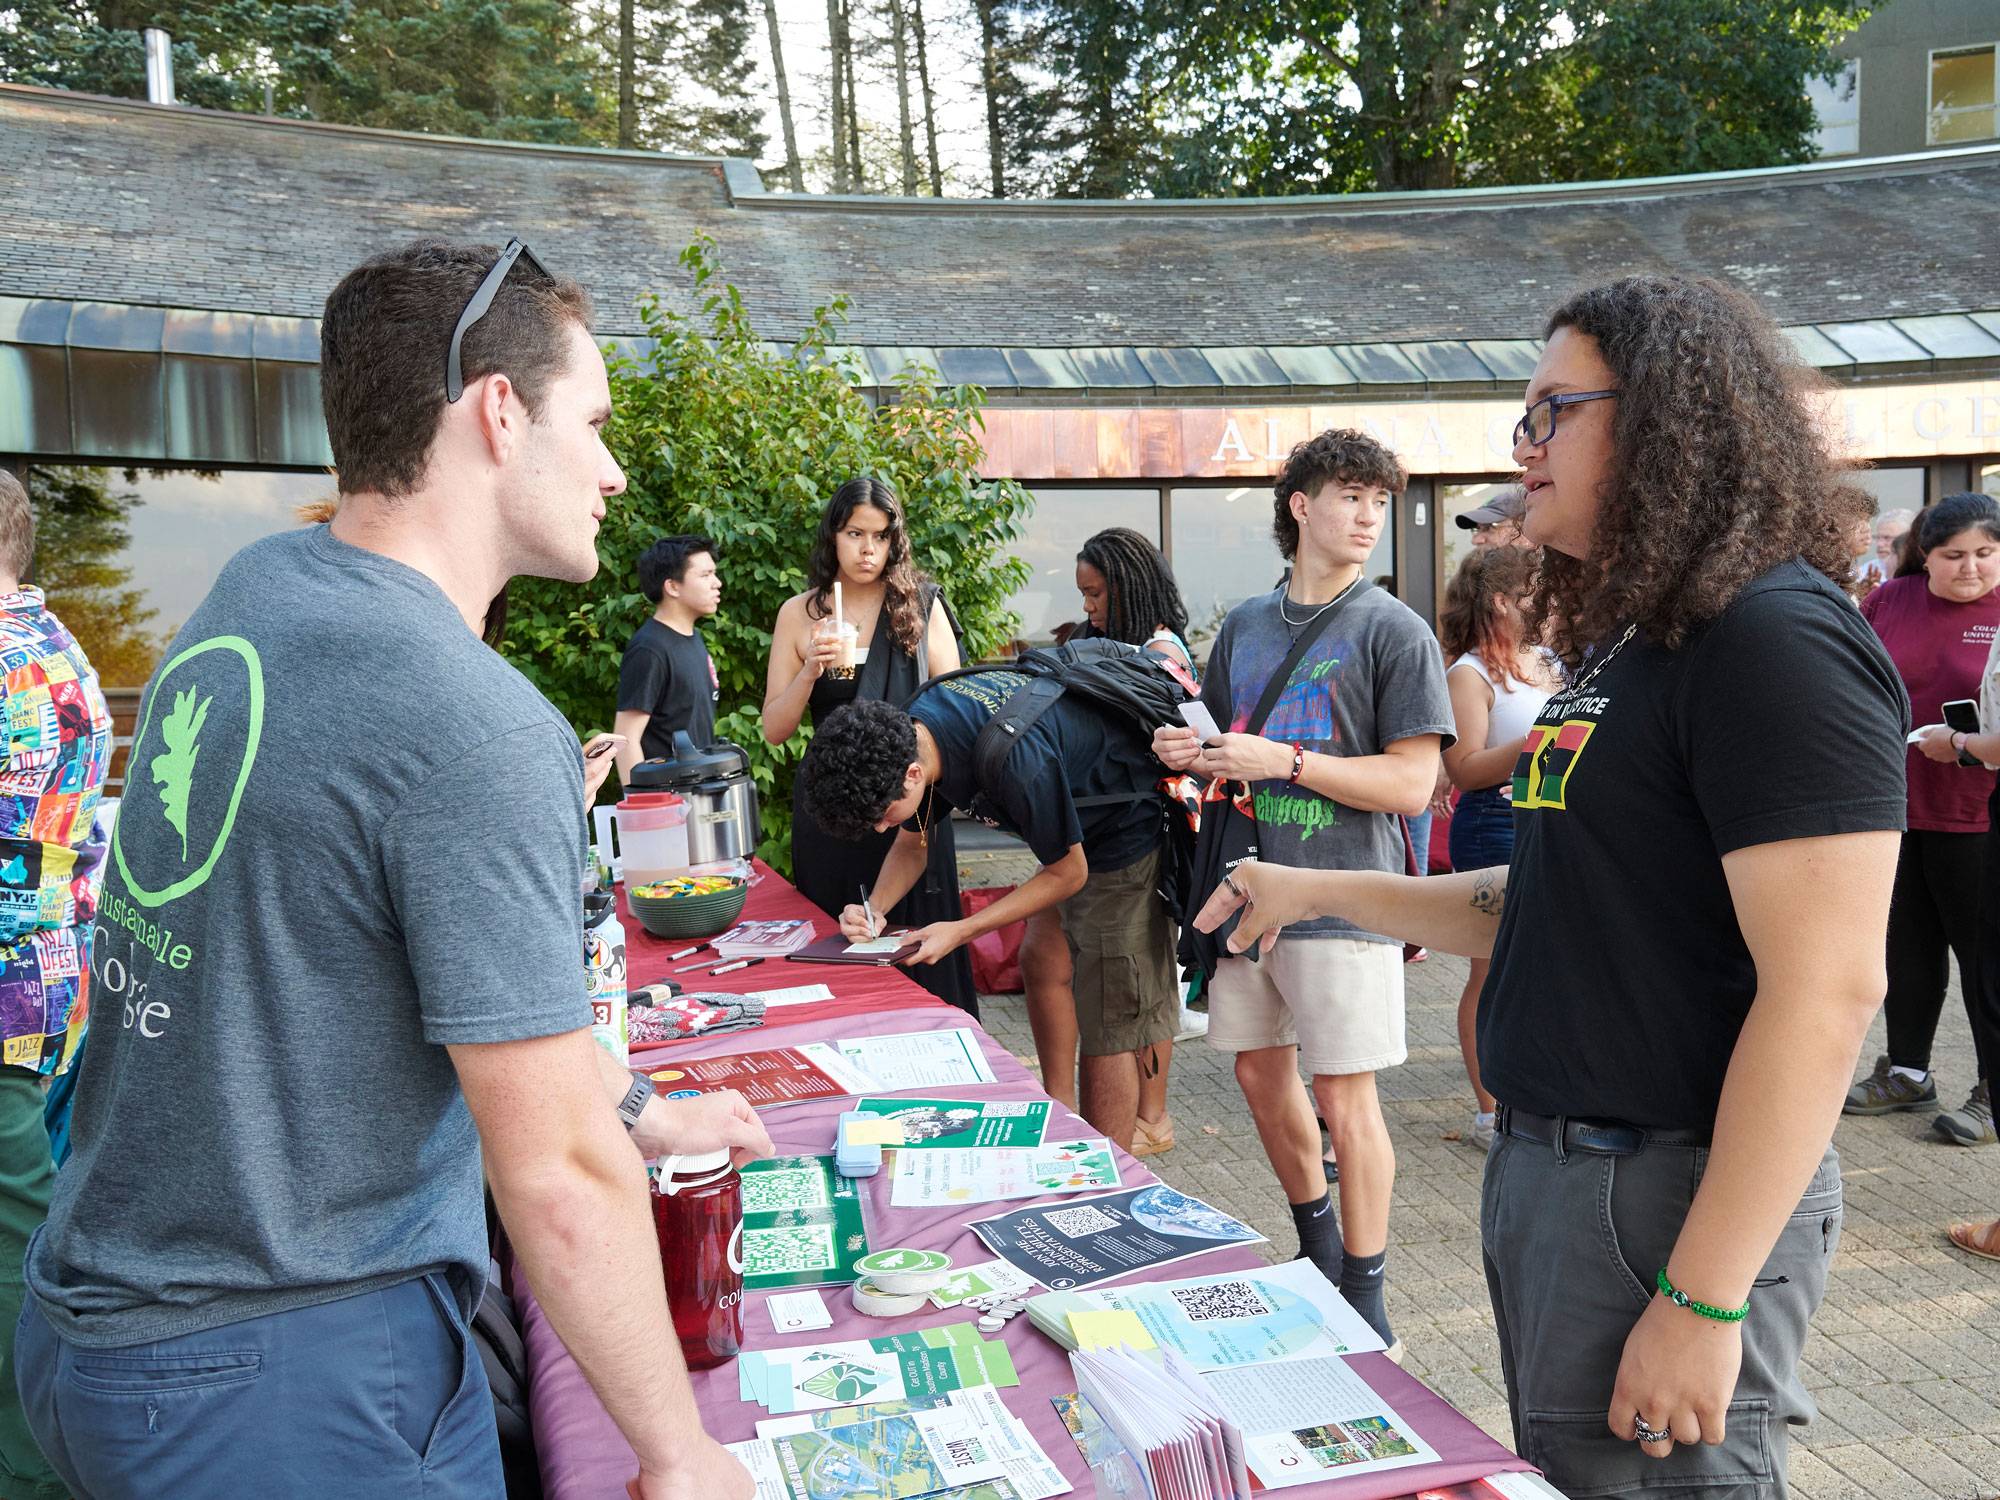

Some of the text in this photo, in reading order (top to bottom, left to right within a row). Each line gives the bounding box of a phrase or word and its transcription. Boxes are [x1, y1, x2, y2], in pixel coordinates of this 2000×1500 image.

[1211, 414, 1452, 462] ALNA
[97, 880, 193, 970] Sustanale
[91, 925, 171, 1038] Colge
[1014, 1224, 1090, 1275] SUSTAINABILITY
[1015, 1239, 1060, 1268] JOIN THE
[1022, 1217, 1106, 1273] REPRESENTATIVES
[945, 1440, 976, 1468] WASTE
[963, 1436, 991, 1465] RETHINK
